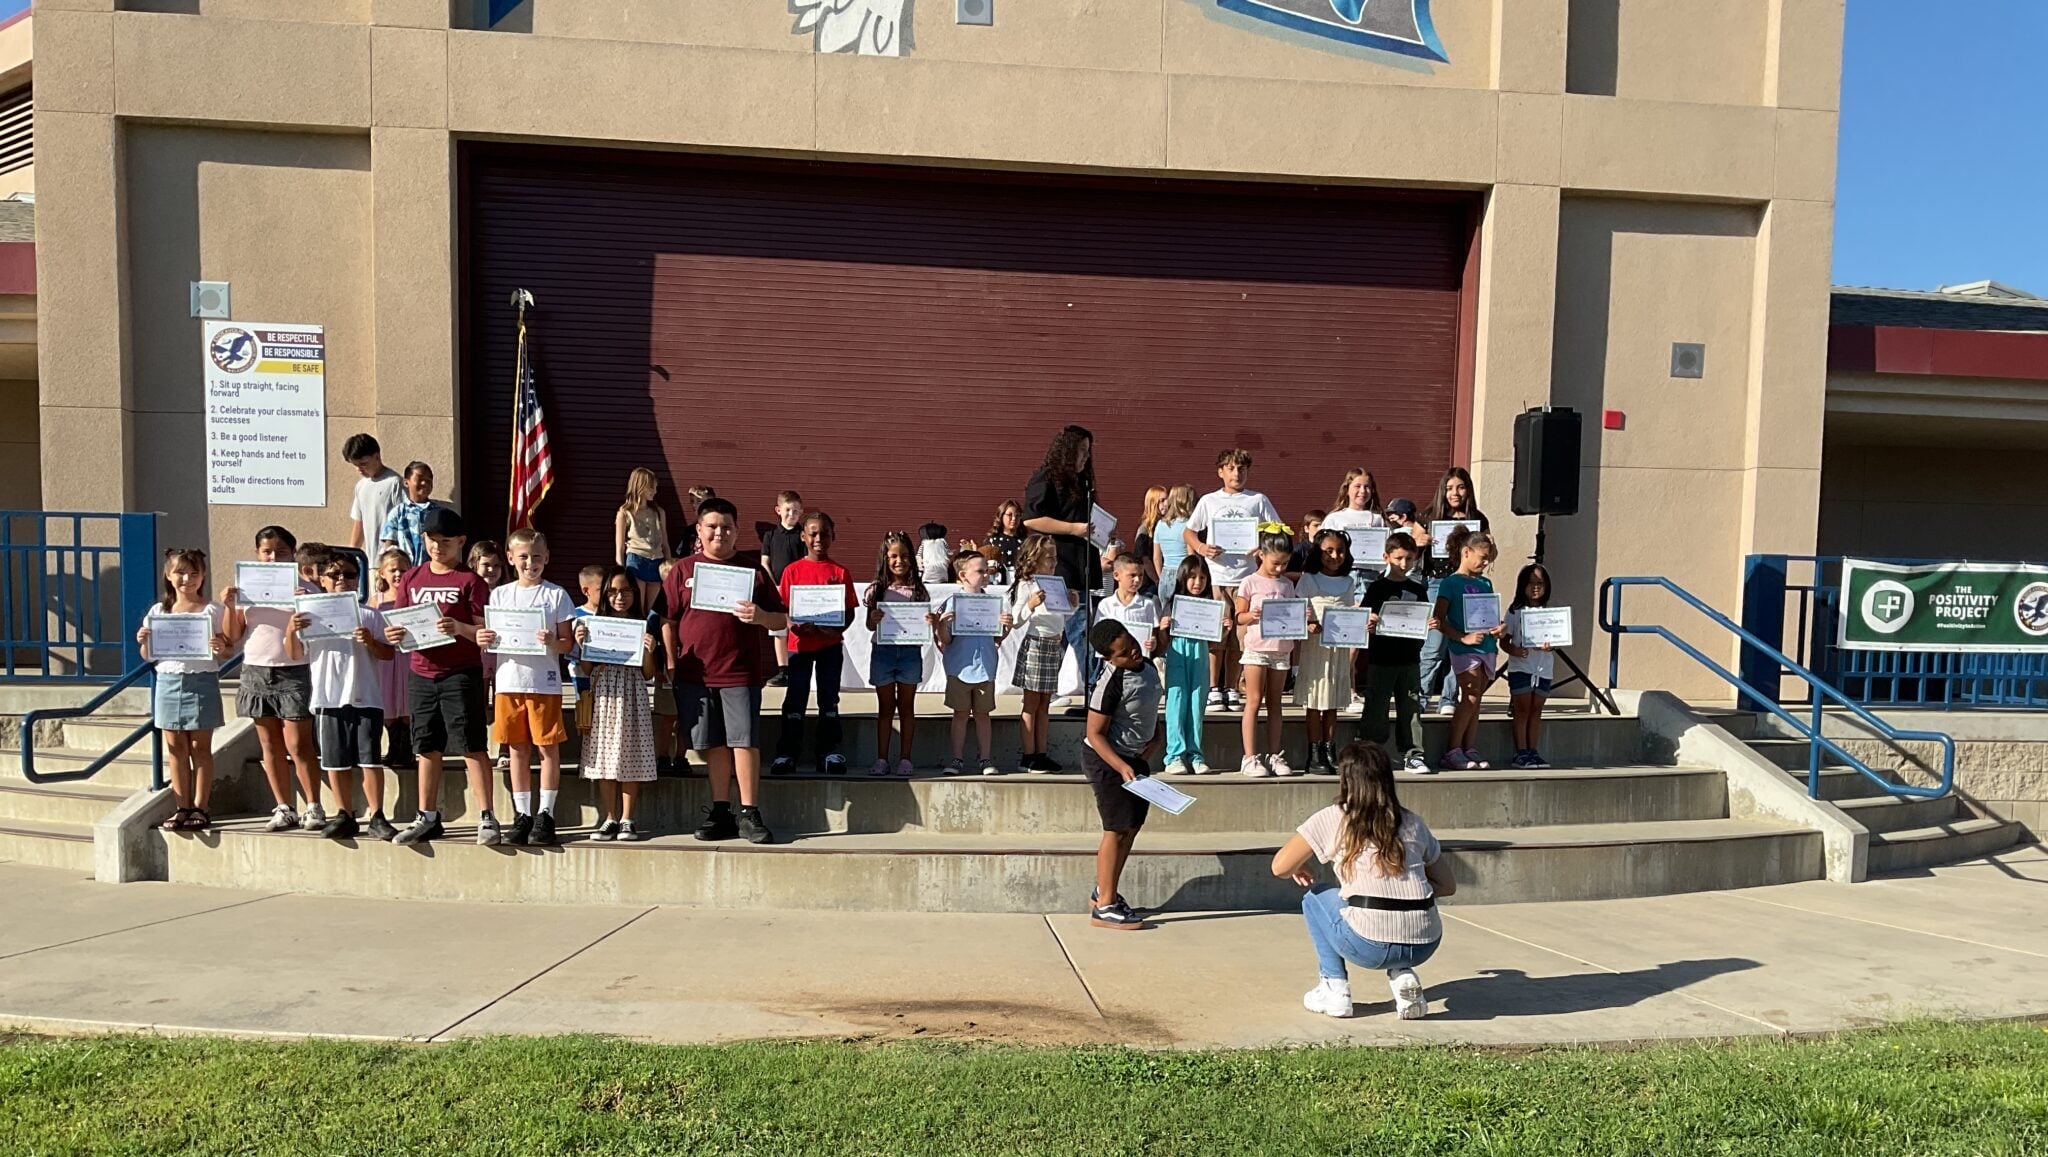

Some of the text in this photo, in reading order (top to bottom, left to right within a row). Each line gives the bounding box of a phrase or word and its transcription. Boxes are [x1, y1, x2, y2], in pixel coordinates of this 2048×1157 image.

[267, 333, 319, 343] BE RESPECTFUL
[264, 348, 319, 358] BE RESPONSIBLE
[303, 364, 319, 373] SAFE
[220, 380, 230, 389] Sit
[232, 383, 241, 392] up
[243, 382, 274, 391] straight,
[276, 384, 299, 392] facing
[210, 389, 239, 397] forward
[220, 406, 256, 415] Celebrate
[276, 408, 320, 417] classmate's
[239, 434, 257, 443] good
[220, 450, 240, 459] Keep
[241, 450, 264, 458] hands
[212, 459, 243, 468] yourself
[221, 476, 246, 484] Follow
[247, 476, 285, 485] directions
[410, 586, 460, 604] VANS
[1929, 594, 1999, 605] POSITIVITY
[1936, 607, 1989, 619] PROJECT
